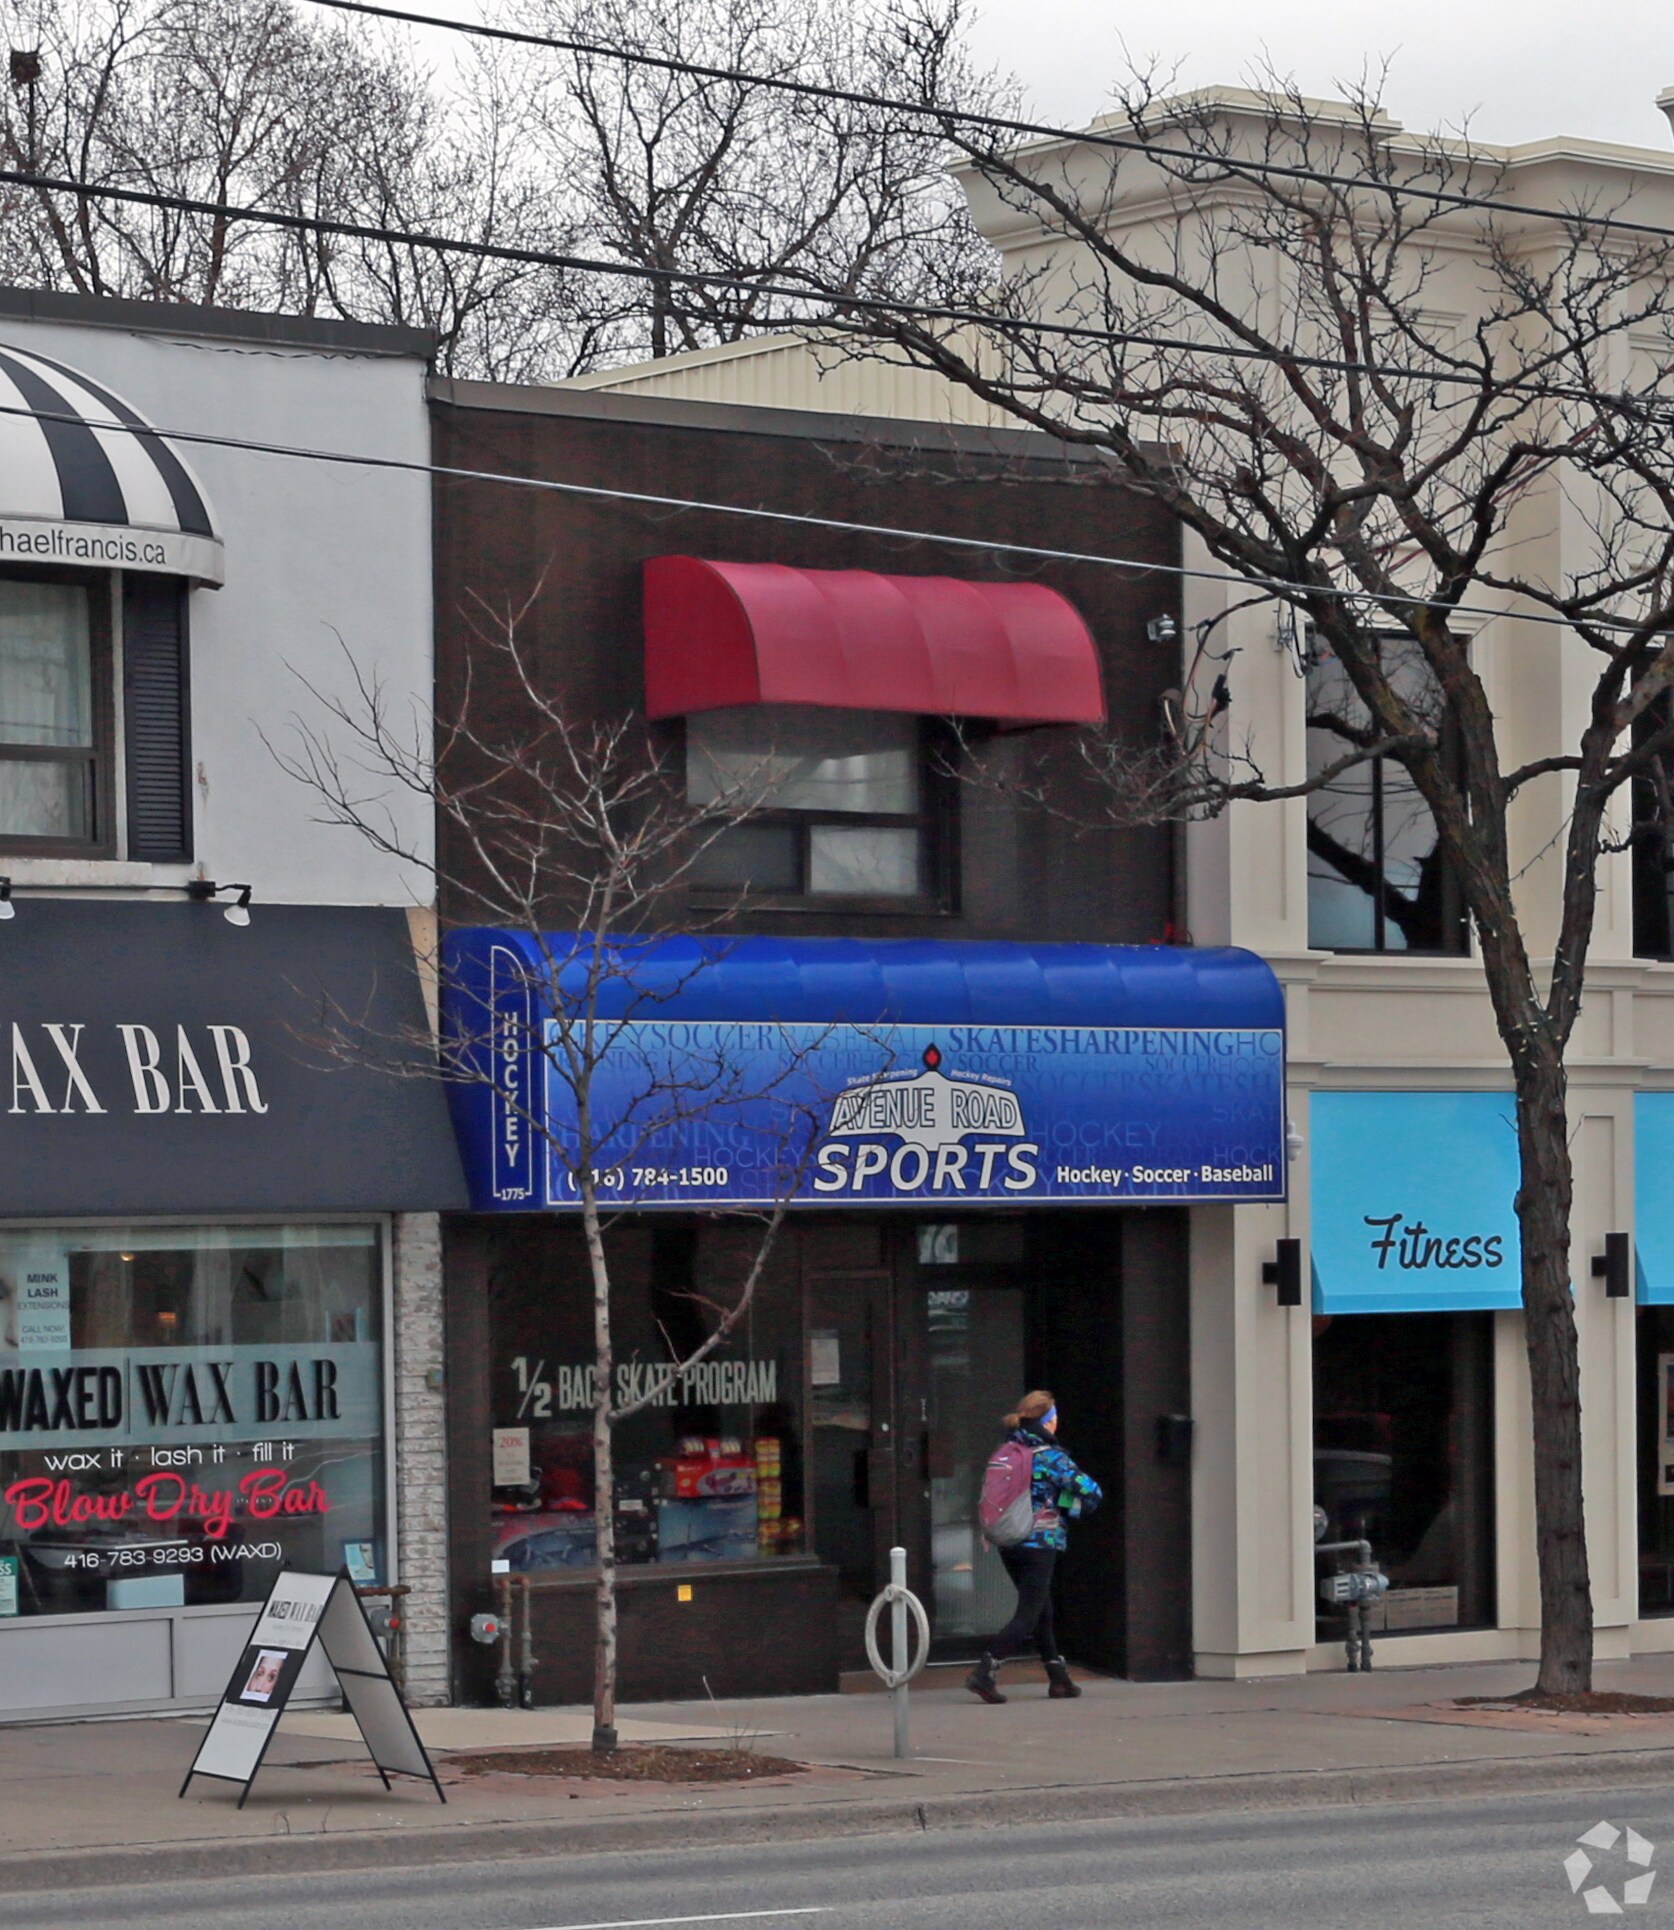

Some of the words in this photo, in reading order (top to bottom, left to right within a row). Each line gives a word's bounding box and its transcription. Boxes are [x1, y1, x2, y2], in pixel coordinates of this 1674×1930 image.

[115, 1024, 269, 1114] BAR
[503, 1012, 519, 1168] HOCKEY
[836, 1088, 935, 1130] AVENUE
[951, 1088, 1017, 1129] ROAD
[567, 1168, 625, 1192] (16)
[632, 1167, 728, 1187] 784-1500
[813, 1143, 1039, 1192] SPORTS
[1057, 1165, 1122, 1188] Hockey
[1132, 1165, 1191, 1184] Soccer
[1201, 1164, 1273, 1183] Baseball
[500, 1187, 525, 1200] 1775
[1363, 1213, 1503, 1270] Fitness
[27, 1273, 58, 1283] MINK
[27, 1287, 58, 1298] LASH
[0, 1366, 122, 1432] WAXED
[136, 1361, 239, 1427] WAX
[254, 1359, 342, 1423] BAR
[558, 1364, 598, 1410] BAC
[616, 1361, 678, 1407] SKATE
[682, 1360, 777, 1406] PROGRAM
[44, 1452, 102, 1471] wax
[110, 1448, 125, 1468] it
[151, 1445, 202, 1466] lash
[213, 1444, 226, 1464] it
[252, 1442, 273, 1462] fill
[282, 1441, 295, 1461] it
[4, 1476, 134, 1530] Blow
[134, 1472, 234, 1539] Dry
[239, 1468, 332, 1519] Bar
[63, 1547, 205, 1568] 416-783-9293
[210, 1541, 283, 1564] (WAXD)
